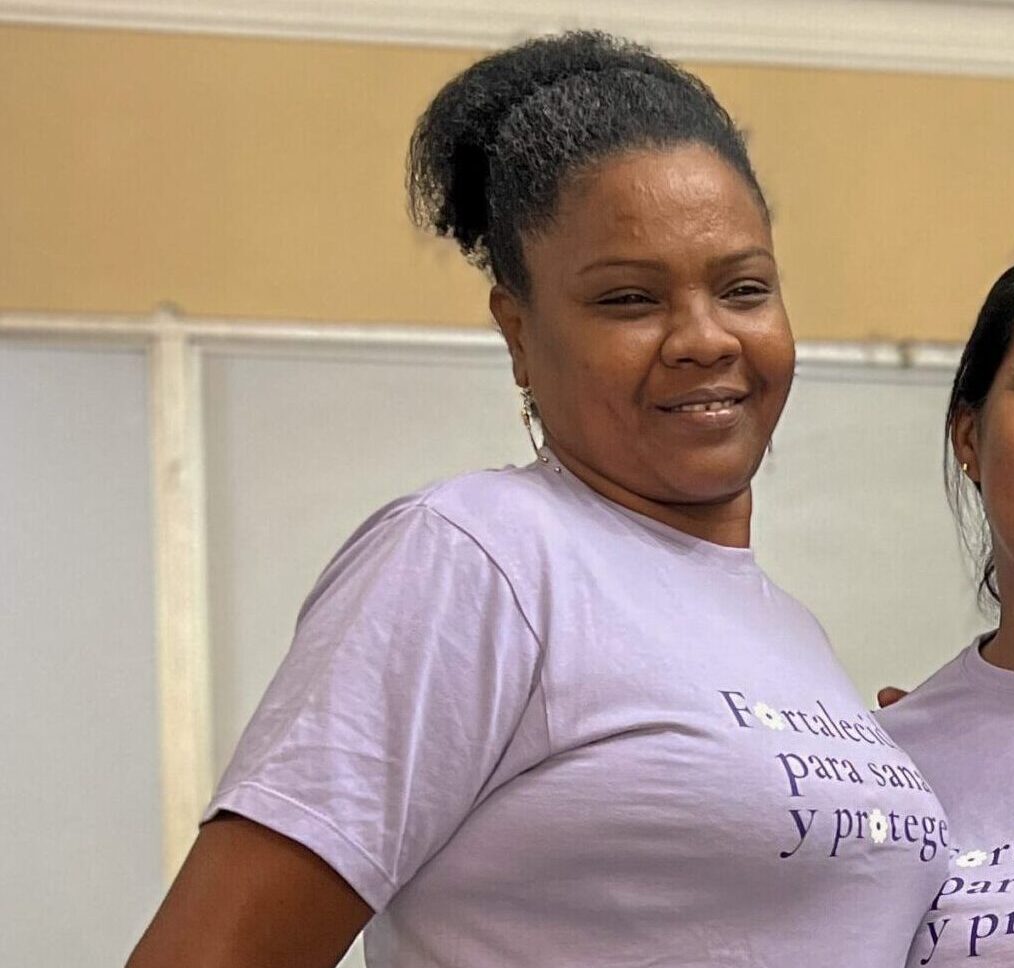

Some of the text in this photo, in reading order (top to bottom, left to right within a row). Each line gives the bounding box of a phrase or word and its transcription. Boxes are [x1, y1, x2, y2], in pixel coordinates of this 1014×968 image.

[775, 752, 863, 797] para
[779, 809, 818, 859] y
[920, 917, 951, 966] y
